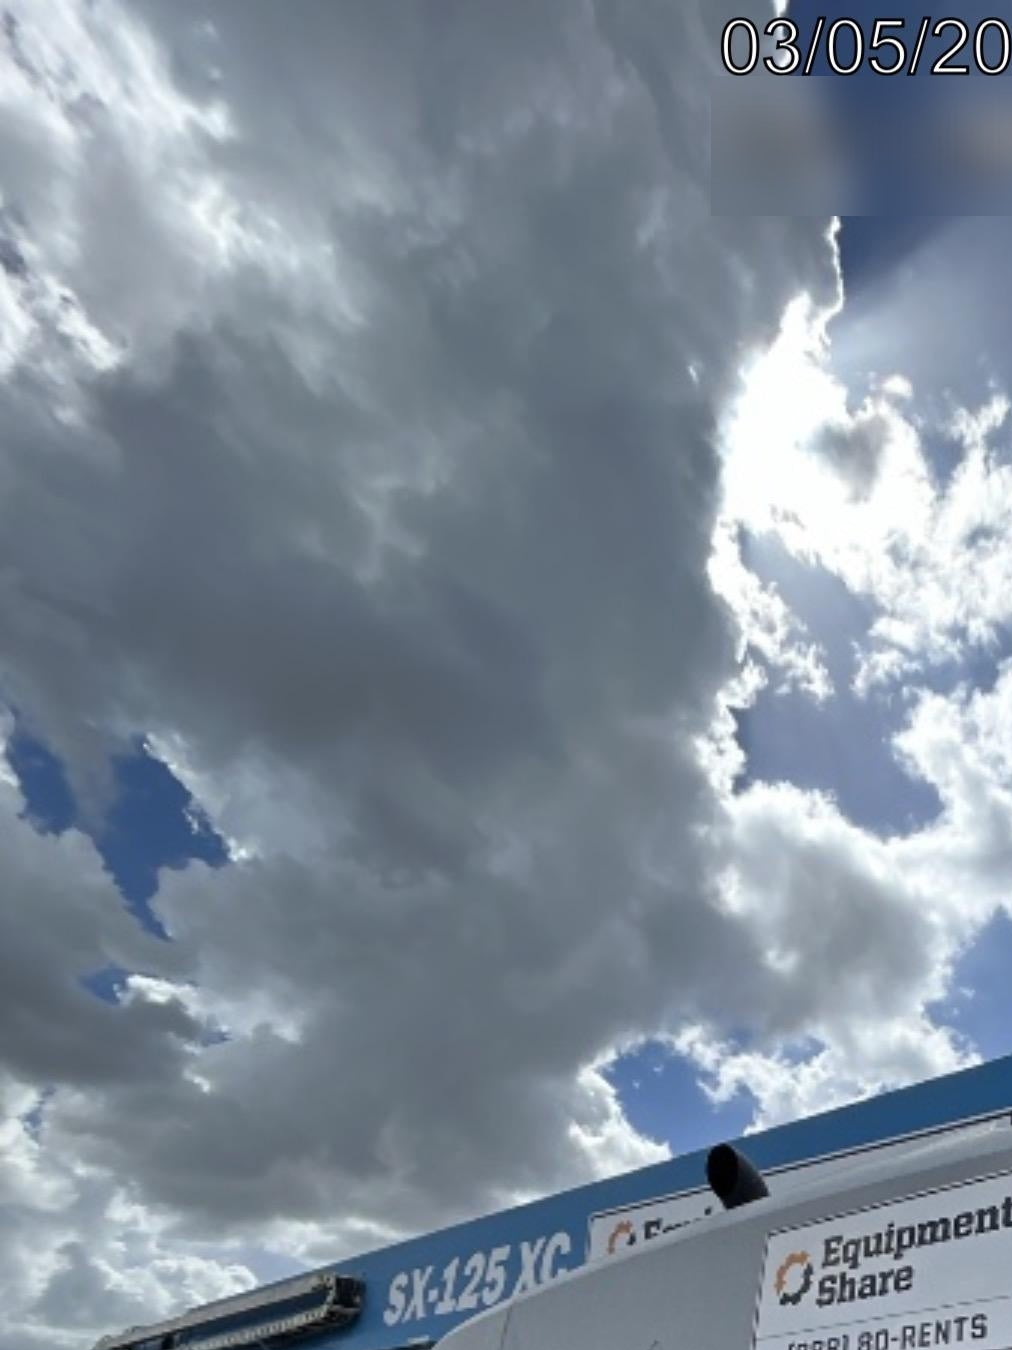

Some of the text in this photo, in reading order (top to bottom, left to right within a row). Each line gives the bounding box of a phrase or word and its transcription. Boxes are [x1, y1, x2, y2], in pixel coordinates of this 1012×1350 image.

[383, 1232, 571, 1327] SX-125 XC
[814, 1264, 914, 1308] Share
